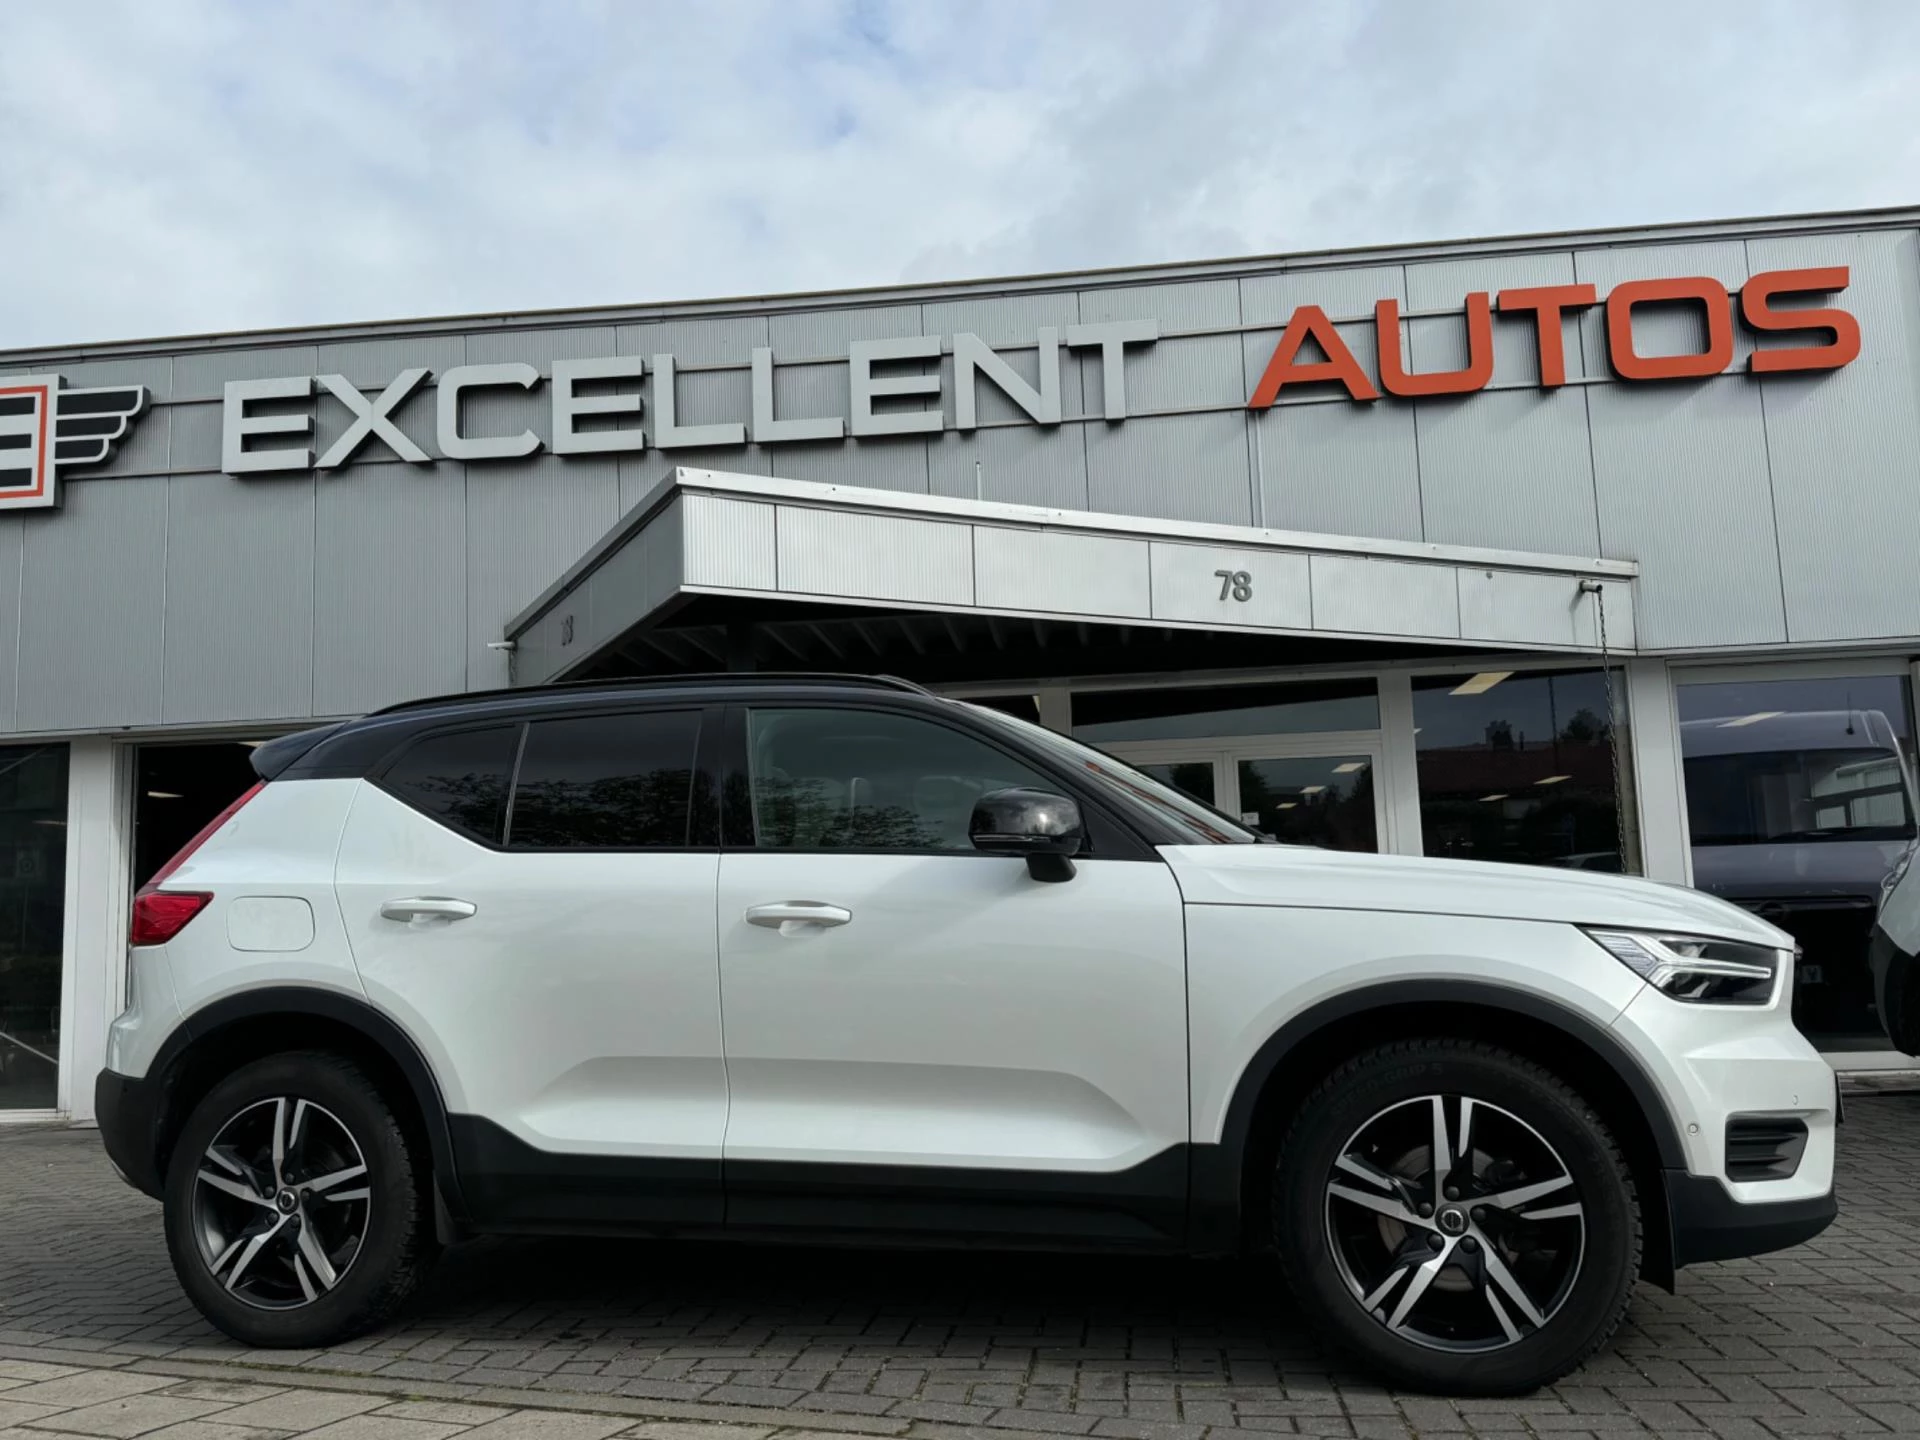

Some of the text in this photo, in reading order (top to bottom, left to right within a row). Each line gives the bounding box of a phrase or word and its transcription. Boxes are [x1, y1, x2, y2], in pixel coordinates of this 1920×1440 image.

[221, 266, 1861, 476] EXCELLENT AUTOS
[1214, 569, 1253, 602] 78
